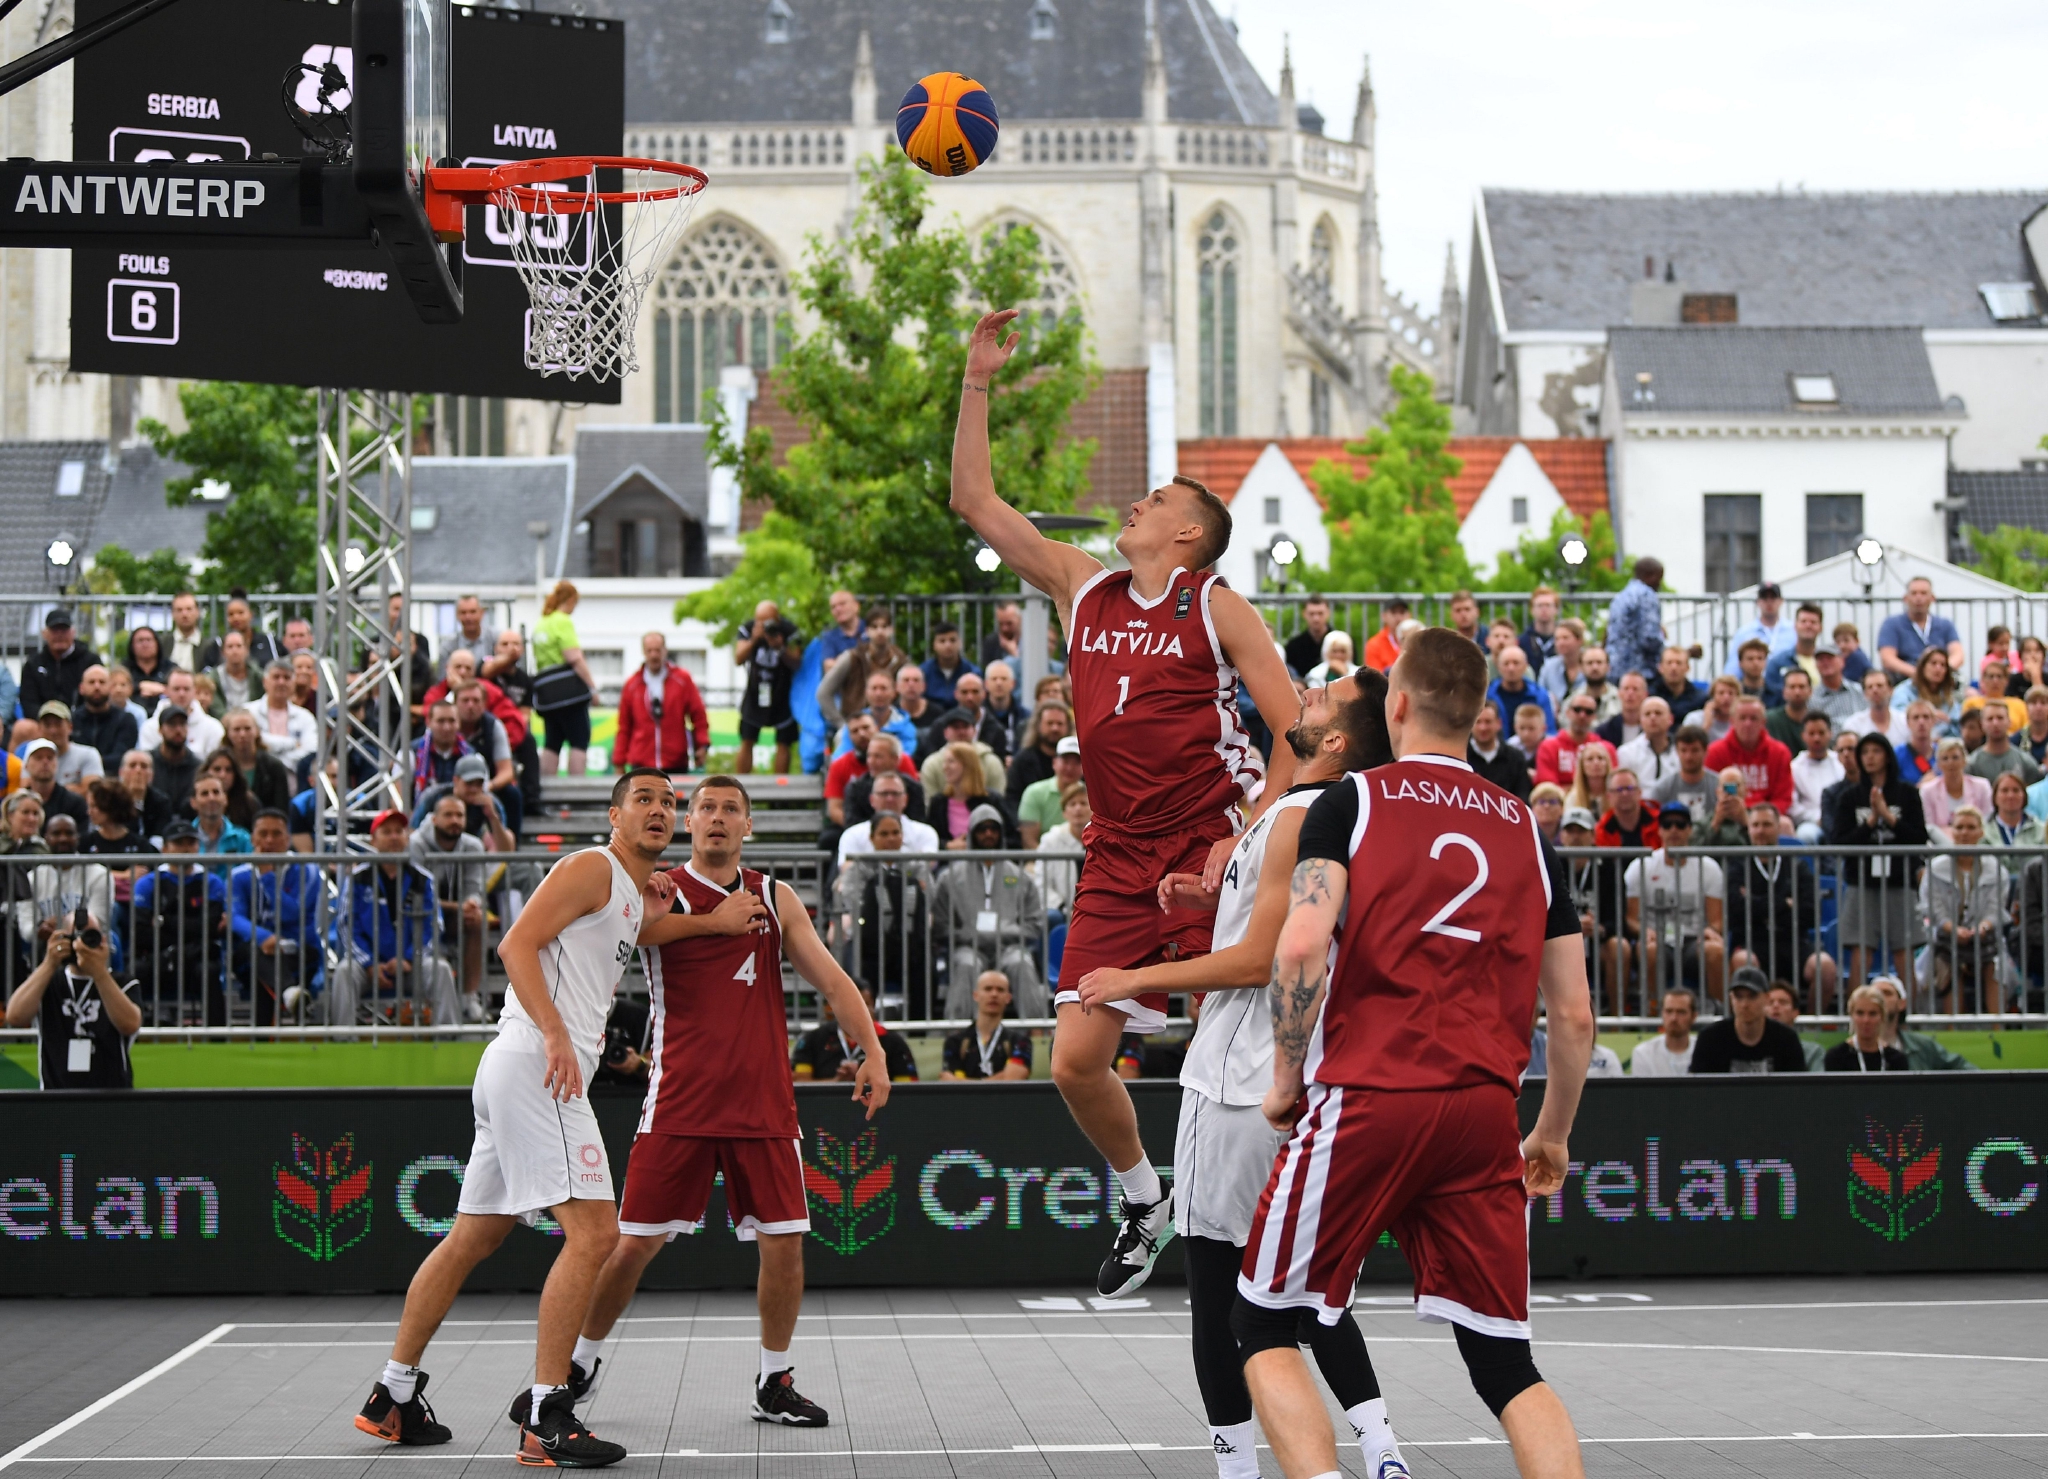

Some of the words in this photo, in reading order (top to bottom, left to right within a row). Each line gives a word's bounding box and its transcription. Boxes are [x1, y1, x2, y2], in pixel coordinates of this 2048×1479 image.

[147, 92, 221, 120] SERBIA
[494, 124, 557, 151] LATVIA
[14, 174, 265, 218] ANTWERP
[119, 253, 170, 276] FOULS
[131, 290, 157, 331] 6
[1081, 625, 1183, 659] LATVIJA
[1114, 675, 1131, 716] 1
[1380, 778, 1521, 825] LASMANIS
[1420, 832, 1489, 942] 2
[732, 951, 757, 987] 4
[581, 1172, 603, 1183] mts
